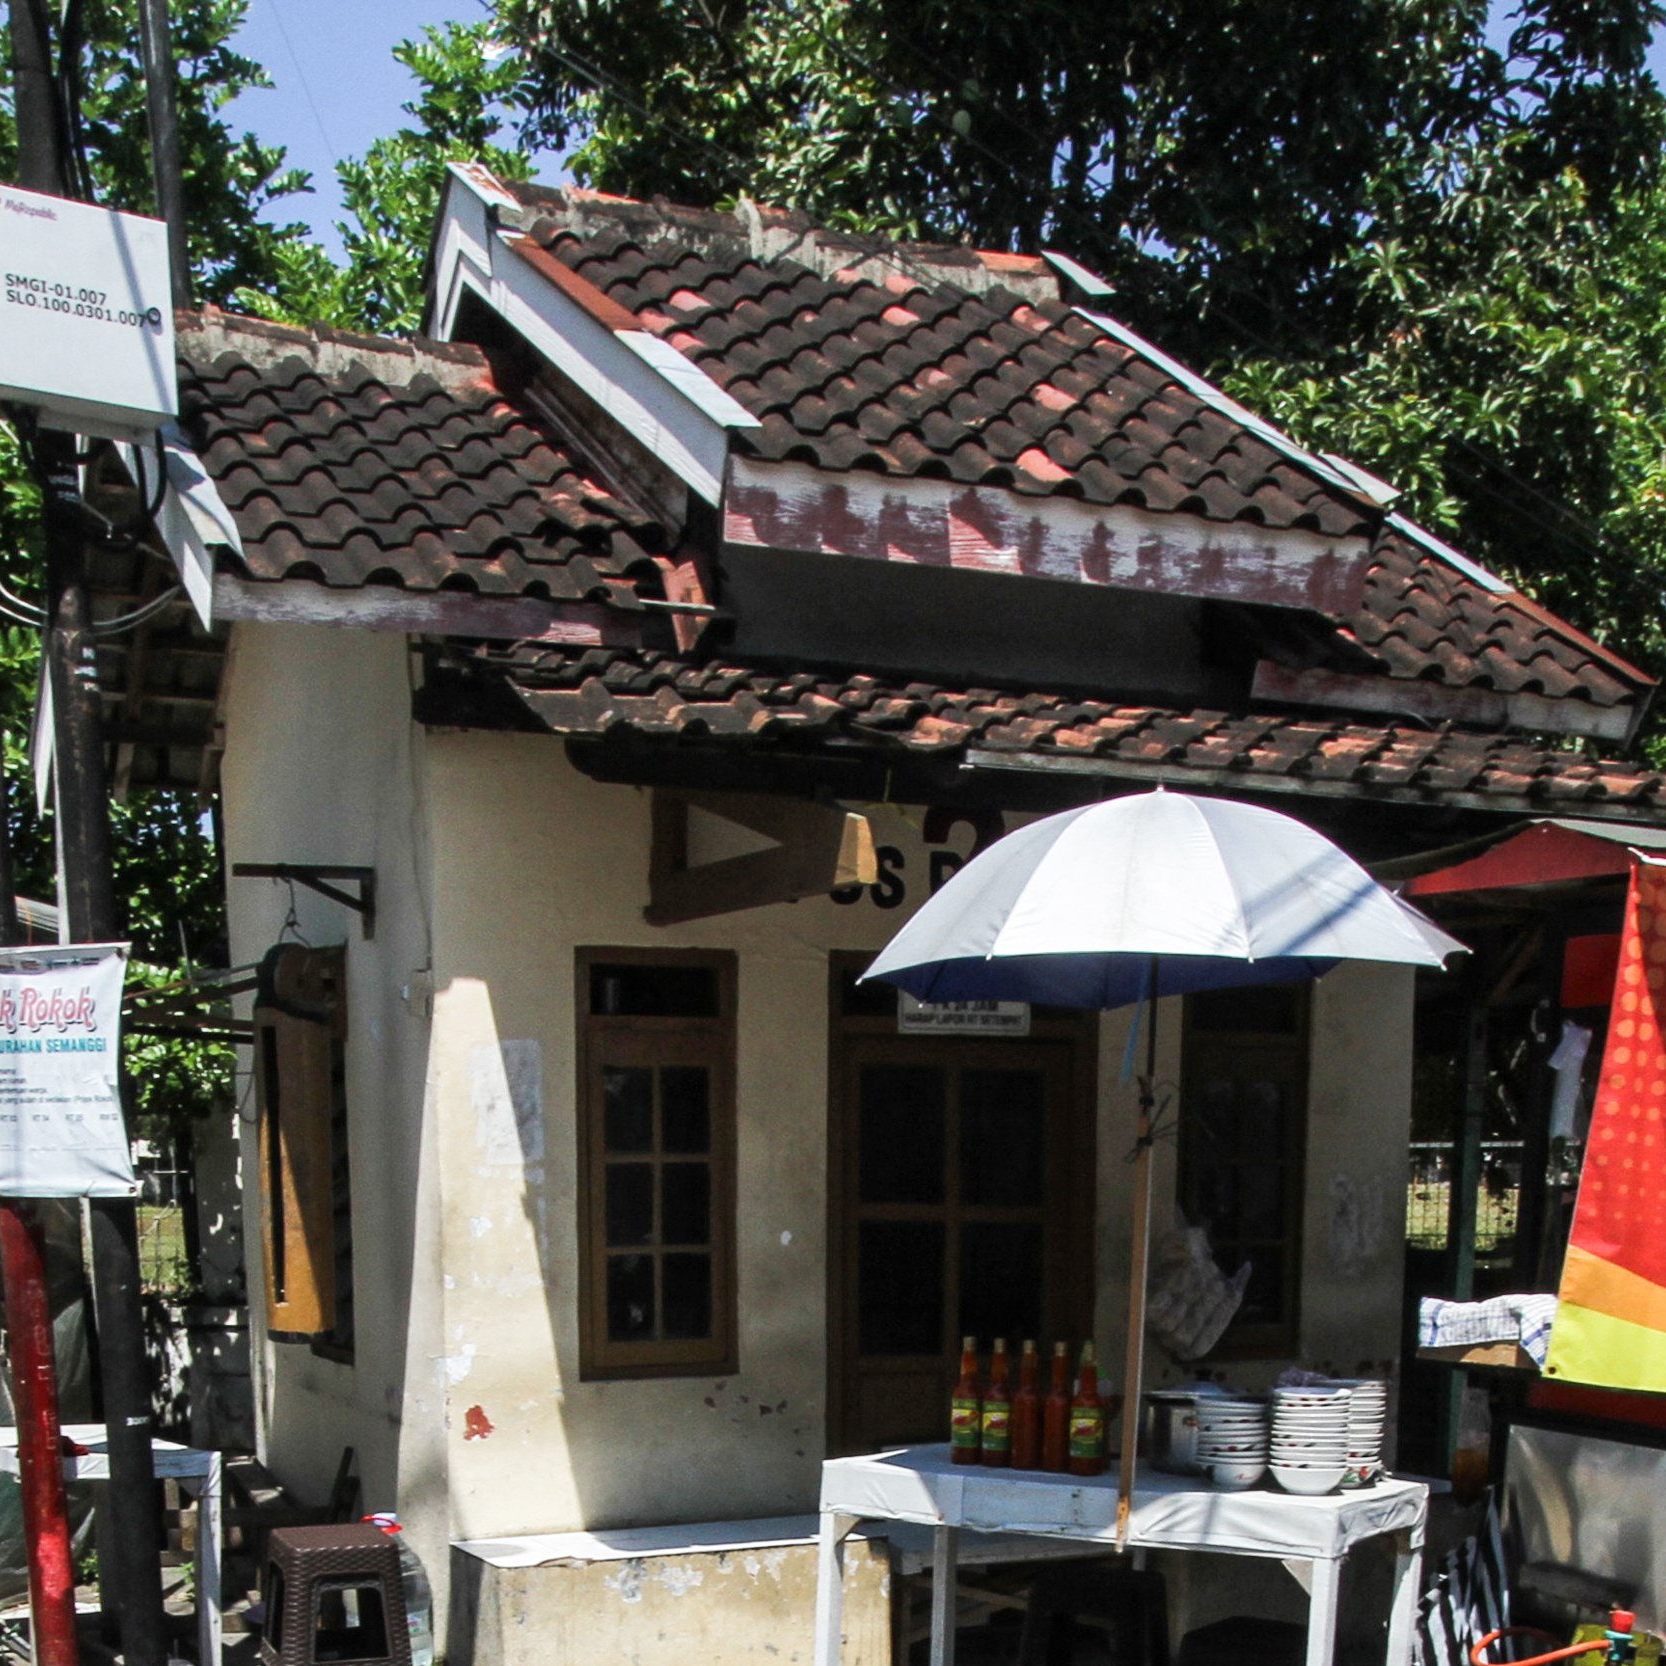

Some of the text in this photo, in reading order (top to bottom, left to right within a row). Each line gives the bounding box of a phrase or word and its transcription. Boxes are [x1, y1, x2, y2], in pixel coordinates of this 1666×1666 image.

[5, 273, 107, 305] SMGI-01.007
[19, 986, 97, 1033] Rokok
[46, 1037, 107, 1053] SEMANGGI
